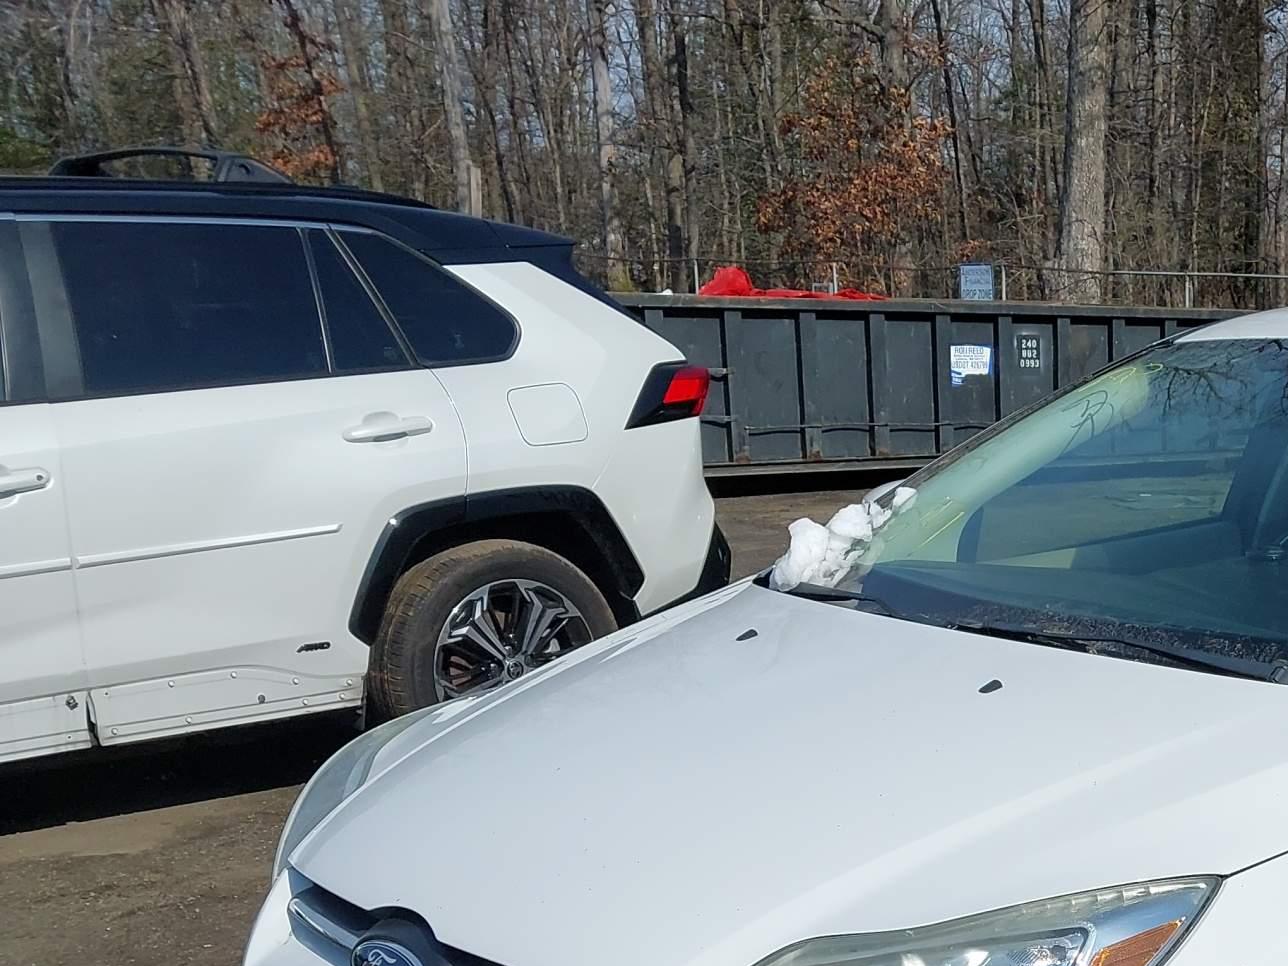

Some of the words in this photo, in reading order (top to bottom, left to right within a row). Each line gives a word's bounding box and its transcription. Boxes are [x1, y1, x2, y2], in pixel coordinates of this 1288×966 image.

[1022, 339, 1037, 348] 240
[1020, 359, 1040, 368] 0993
[296, 641, 331, 653] AWD
